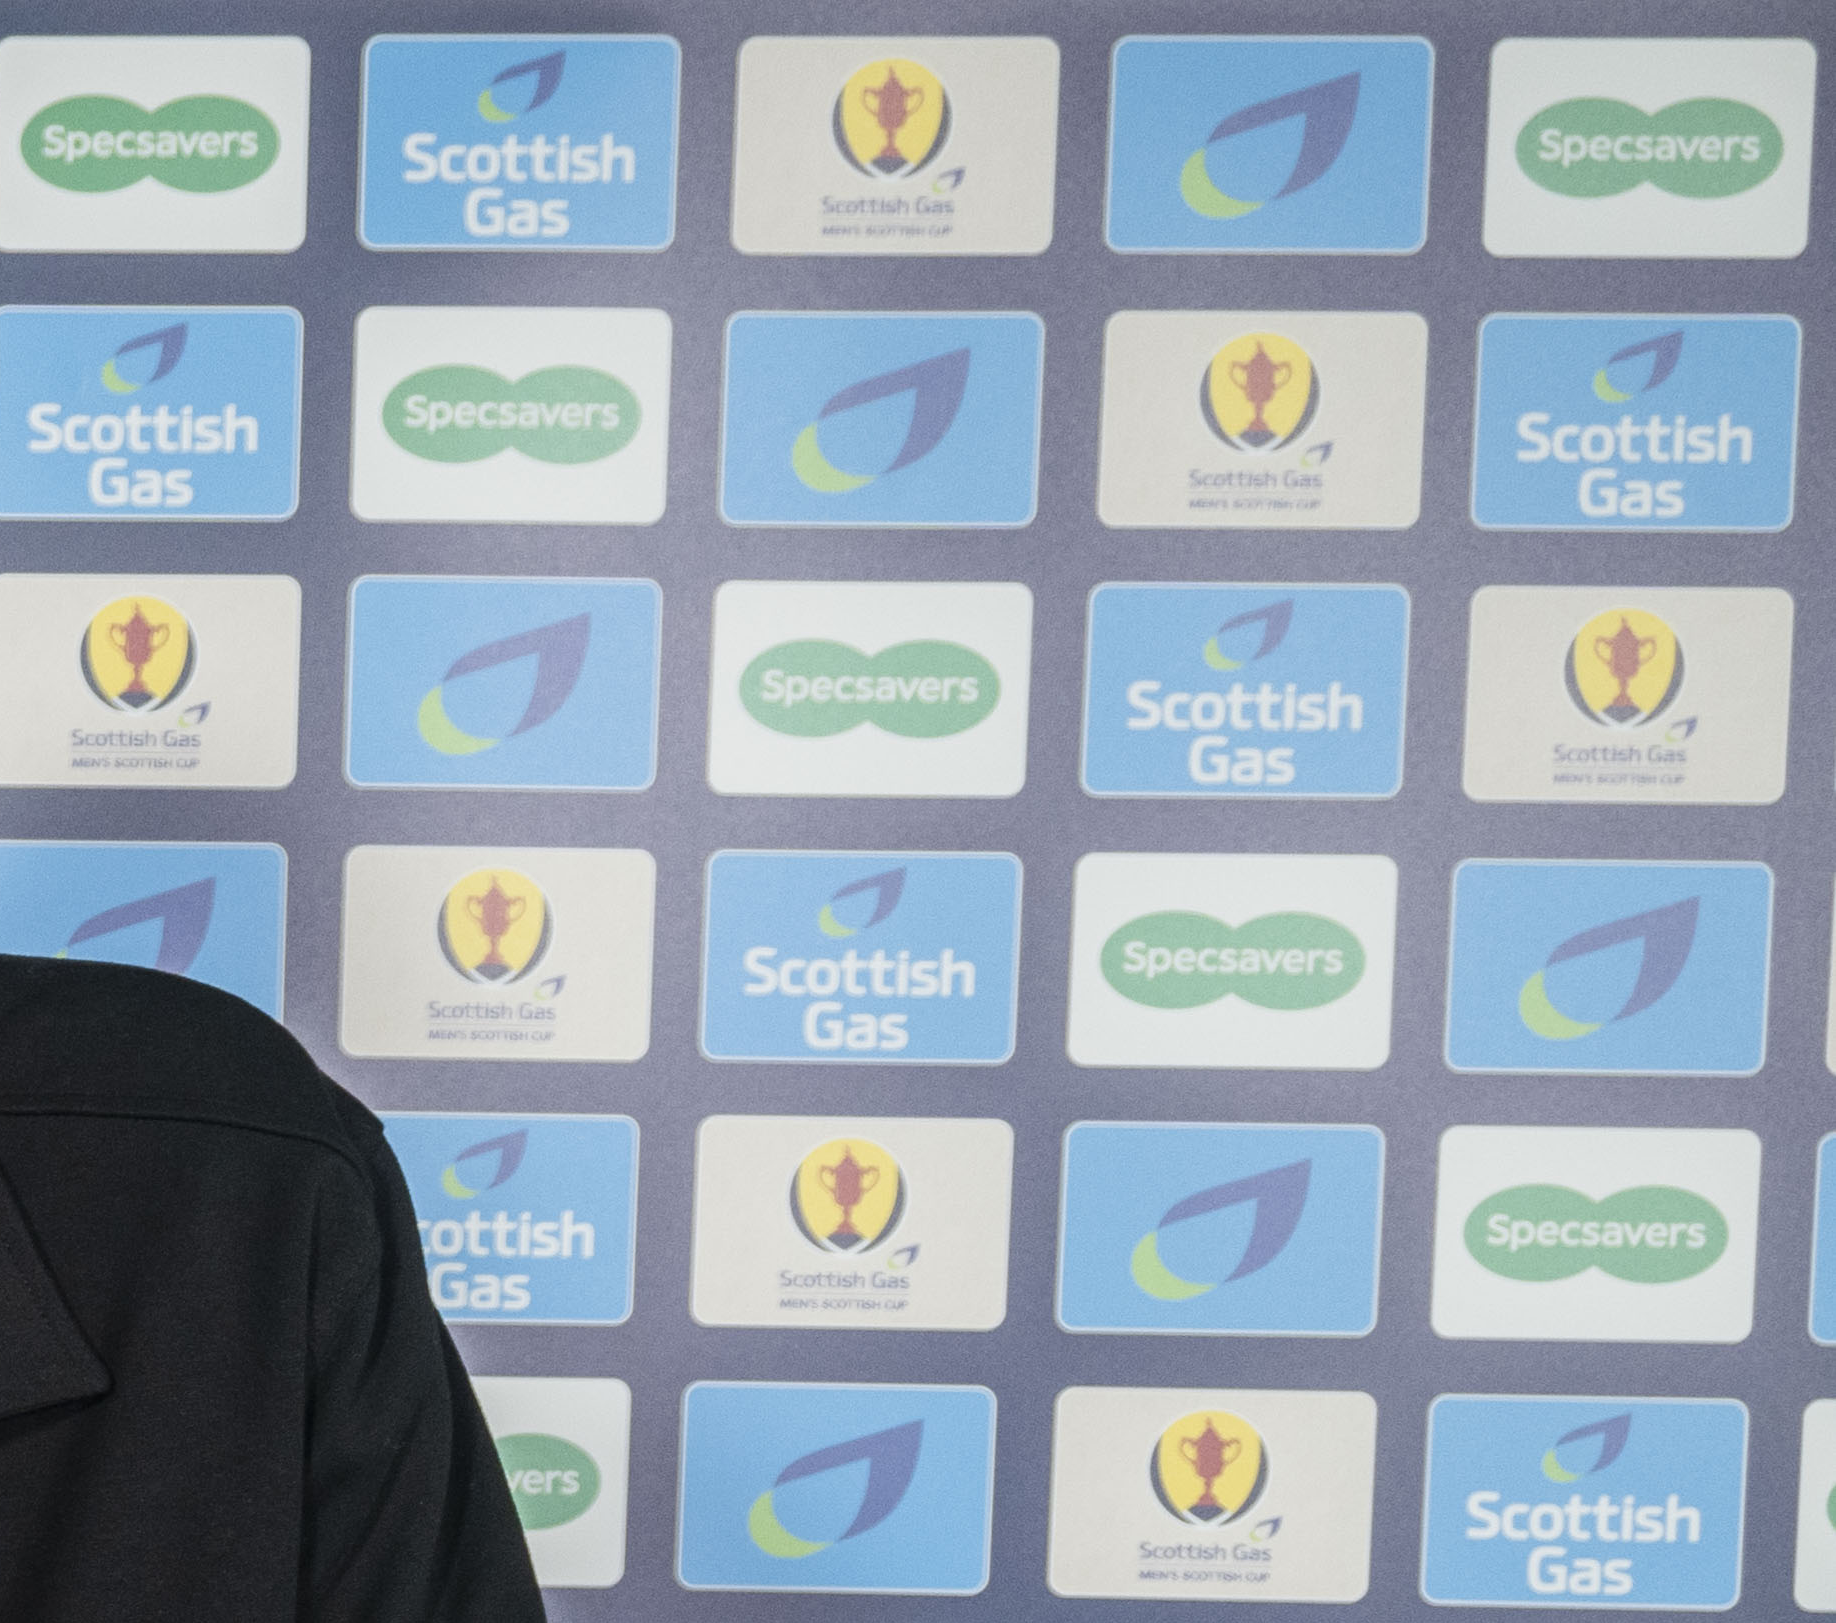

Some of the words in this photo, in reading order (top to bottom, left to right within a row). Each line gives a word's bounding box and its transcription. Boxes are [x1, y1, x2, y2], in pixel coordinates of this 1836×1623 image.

[43, 124, 259, 163] Specsavers
[401, 130, 638, 186] Scottish
[1538, 128, 1760, 168] Specsavers
[461, 184, 573, 240] Gas
[25, 401, 260, 456] Scottish
[404, 394, 621, 432] Specsavers
[1514, 410, 1755, 465] Scottish
[86, 455, 196, 509] Gas
[1576, 465, 1687, 520] Gas
[760, 667, 979, 708] Specsavers
[1125, 678, 1365, 733] Scottish
[1186, 732, 1297, 787] Gas
[741, 944, 977, 999] Scottish
[1122, 939, 1344, 979] Specsavers
[801, 999, 910, 1053] Gas
[1486, 1212, 1707, 1252] Specsavers
[431, 1261, 532, 1312] Gas
[1464, 1489, 1703, 1544] Scottish
[1138, 1541, 1227, 1562] Scottish
[1231, 1543, 1273, 1562] Gas
[1525, 1544, 1635, 1597] Gas
